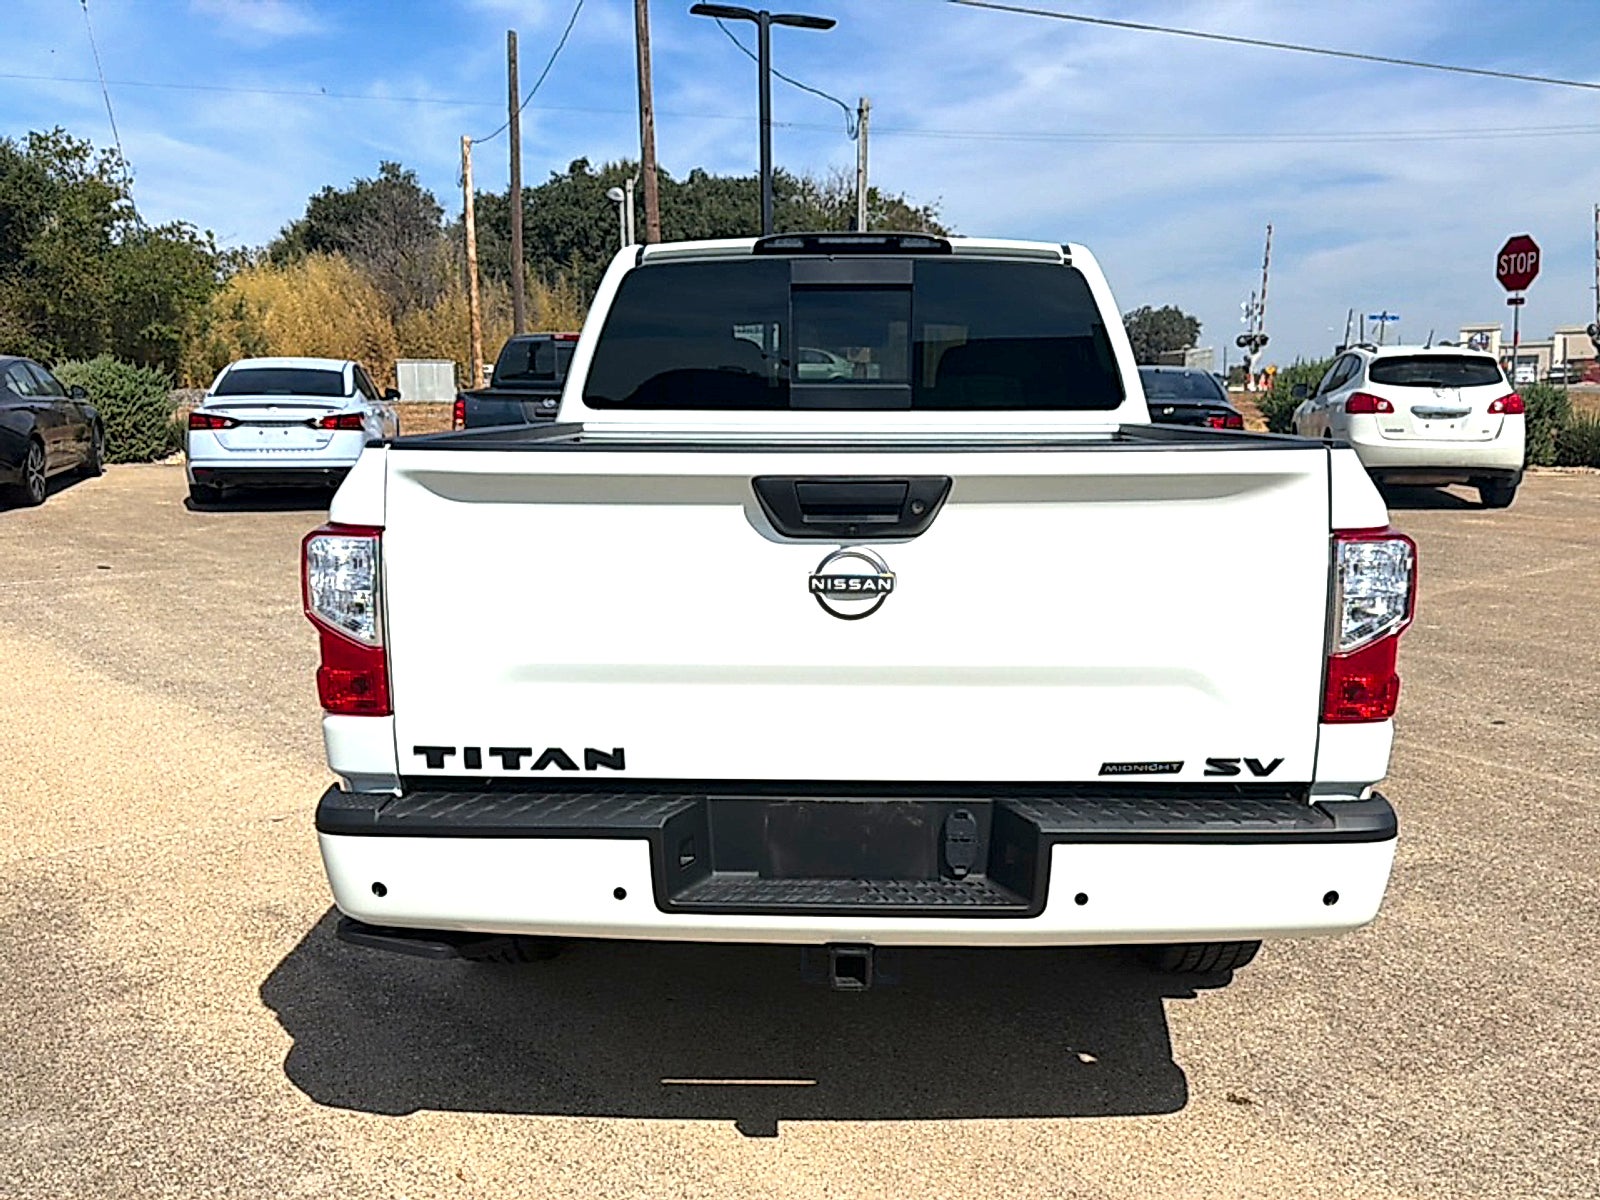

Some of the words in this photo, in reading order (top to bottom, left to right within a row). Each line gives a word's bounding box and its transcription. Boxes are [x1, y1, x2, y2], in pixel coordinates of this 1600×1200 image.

[1498, 251, 1537, 276] STOP
[811, 578, 892, 590] NISSAN
[413, 745, 625, 771] TITAN
[1104, 763, 1181, 773] MIDNIGHT
[1203, 757, 1285, 777] SV
